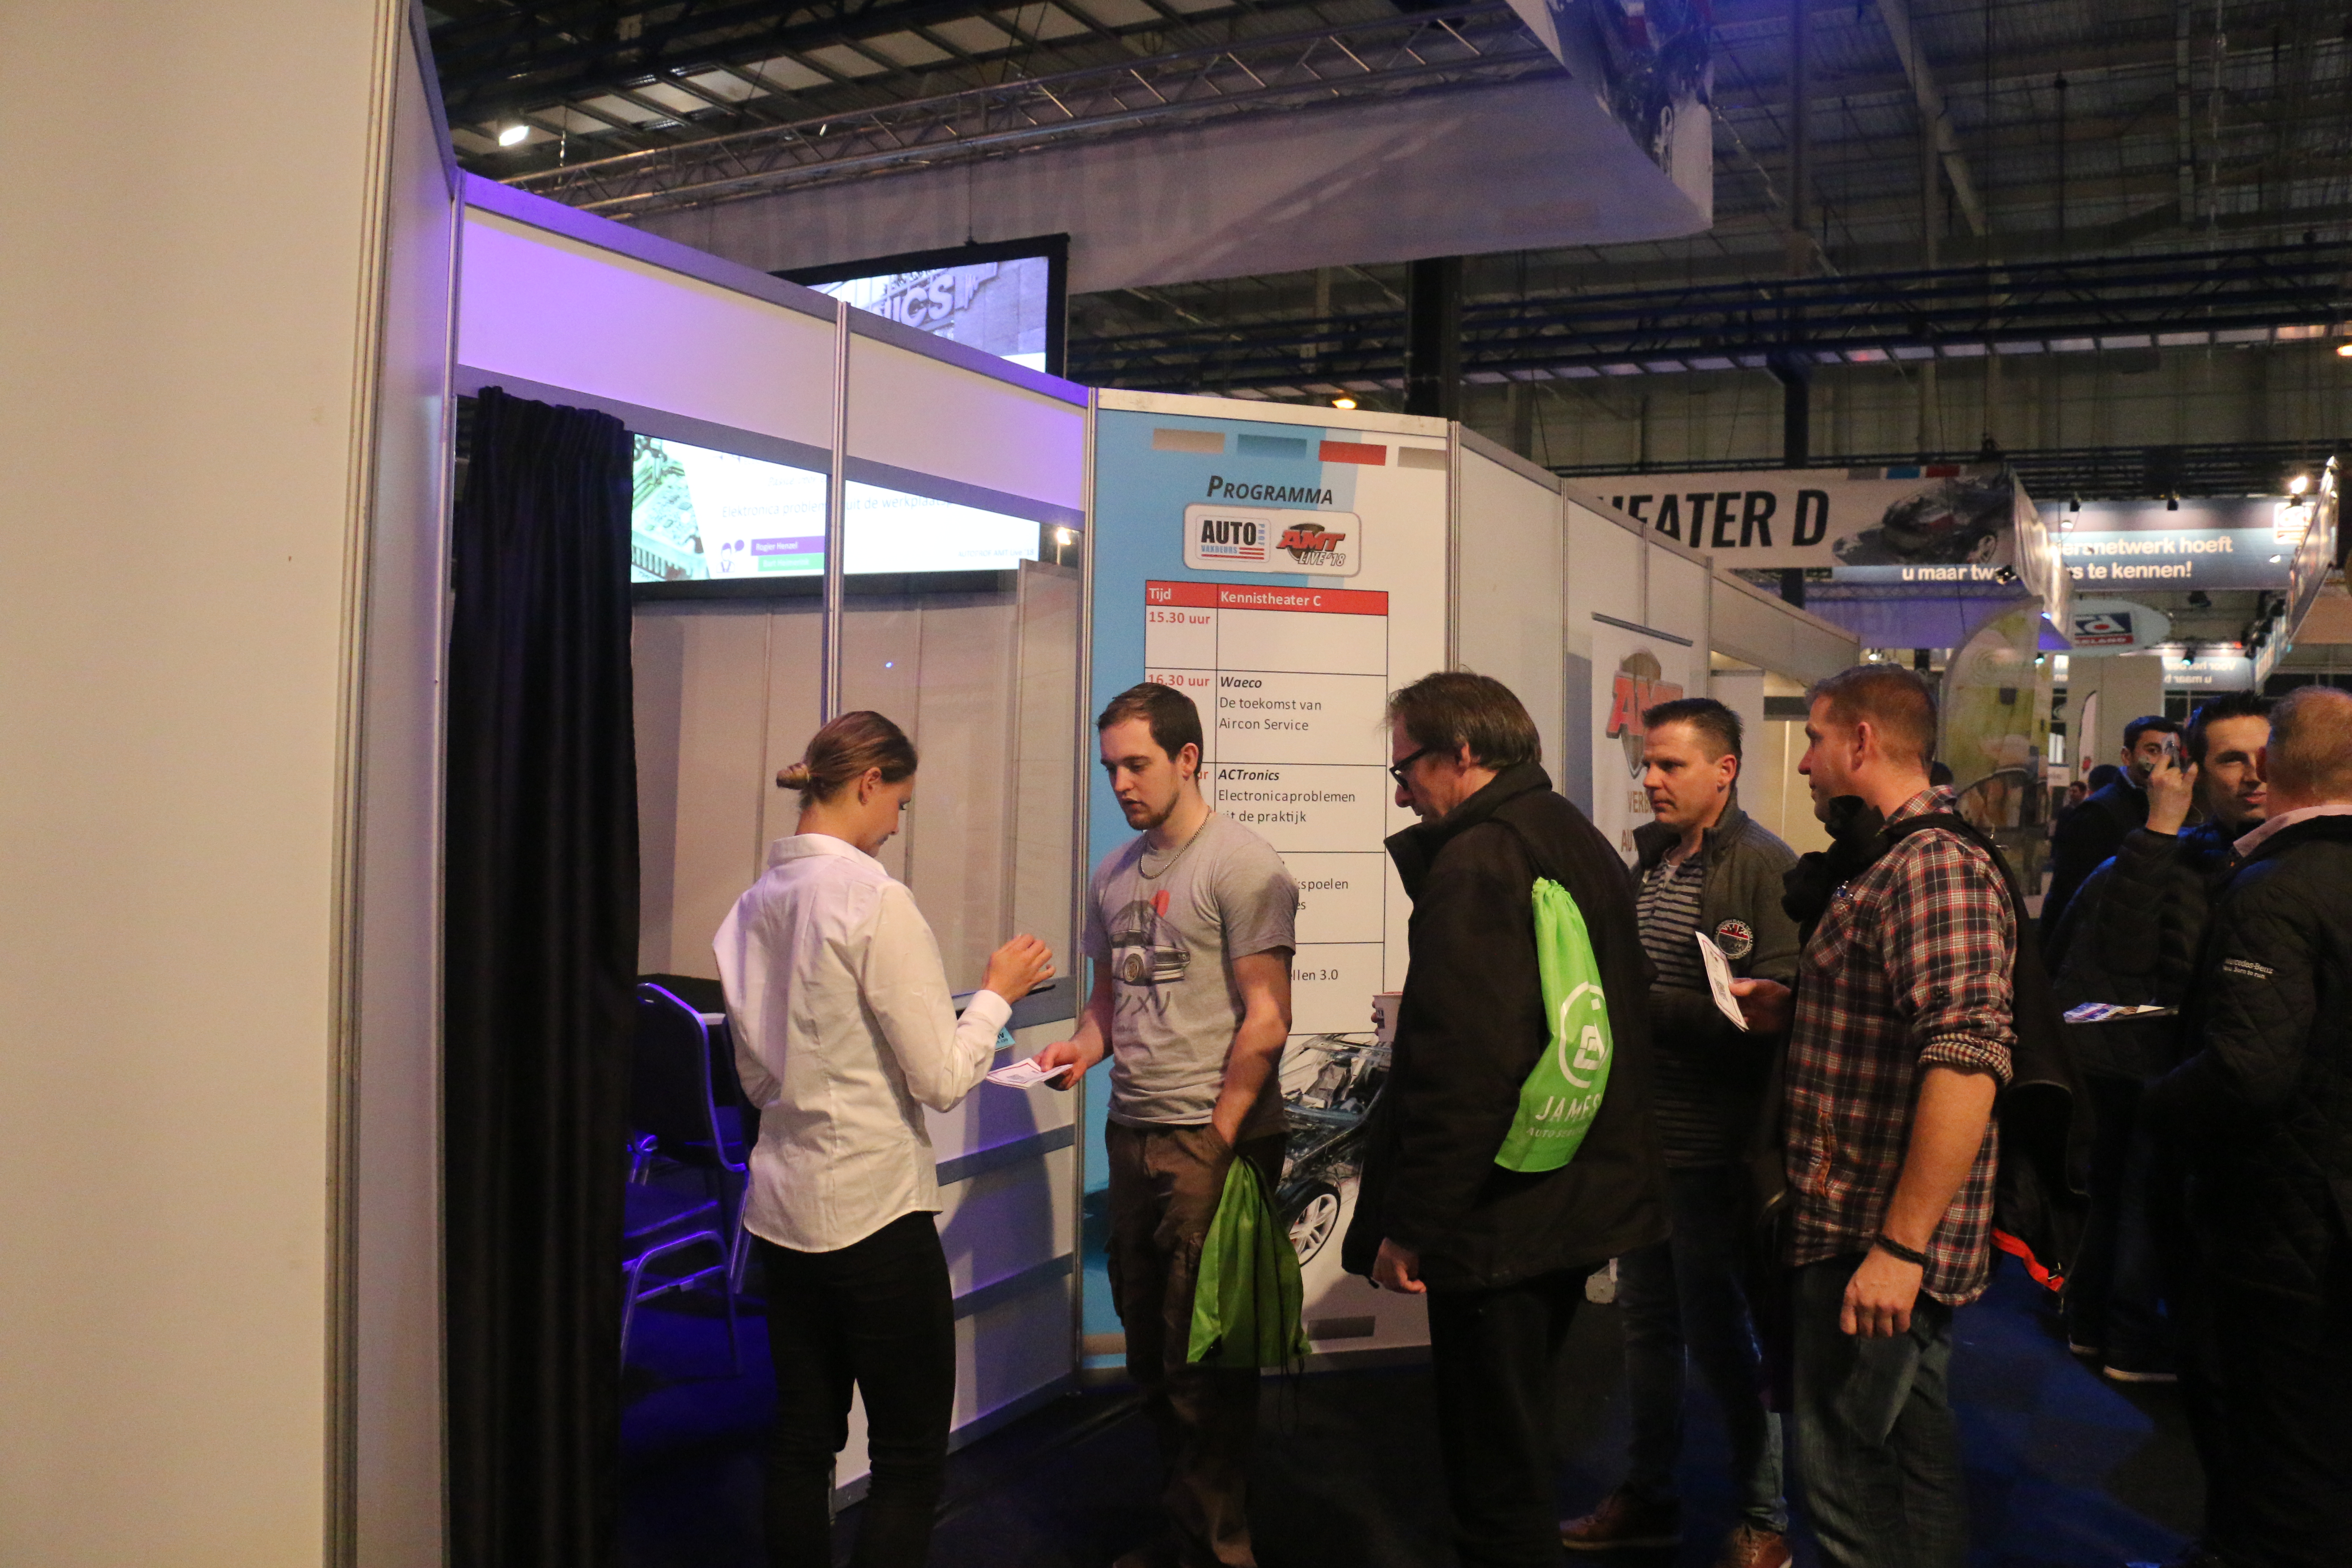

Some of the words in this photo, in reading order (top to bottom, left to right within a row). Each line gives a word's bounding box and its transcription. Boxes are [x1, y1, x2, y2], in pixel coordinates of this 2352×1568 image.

[722, 504, 779, 518] Elektronica
[864, 496, 878, 509] de
[1792, 489, 1829, 546] D
[1201, 520, 1256, 545] AUTO
[756, 543, 775, 551] Rogier
[1276, 530, 1346, 551] AMT
[2179, 536, 2233, 554] hoeft
[1298, 551, 1326, 565] LIVE
[1902, 568, 1914, 581] u
[1918, 567, 1968, 581] maar
[2088, 563, 2107, 579] te
[2112, 561, 2192, 579] kennen!
[1148, 588, 1171, 602] Tijd
[1220, 591, 1310, 606] Kennistheater
[1313, 595, 1321, 606] C
[1149, 611, 1185, 623] 15.30
[1189, 615, 1210, 624] uur
[1148, 674, 1184, 686] 16.30
[1188, 677, 1210, 686] uur
[1220, 676, 1262, 688] Waeco
[1220, 697, 1235, 708] De
[1239, 698, 1296, 710] toekomst
[1300, 701, 1322, 710] van
[1219, 718, 1260, 730] Aircon
[1264, 719, 1309, 731] Service
[1218, 769, 1280, 781] ACTronics
[1219, 790, 1355, 804] Electronicaproblemen
[1239, 810, 1254, 822] de
[1258, 810, 1306, 824] praktijk
[1320, 969, 1338, 980] 3.0
